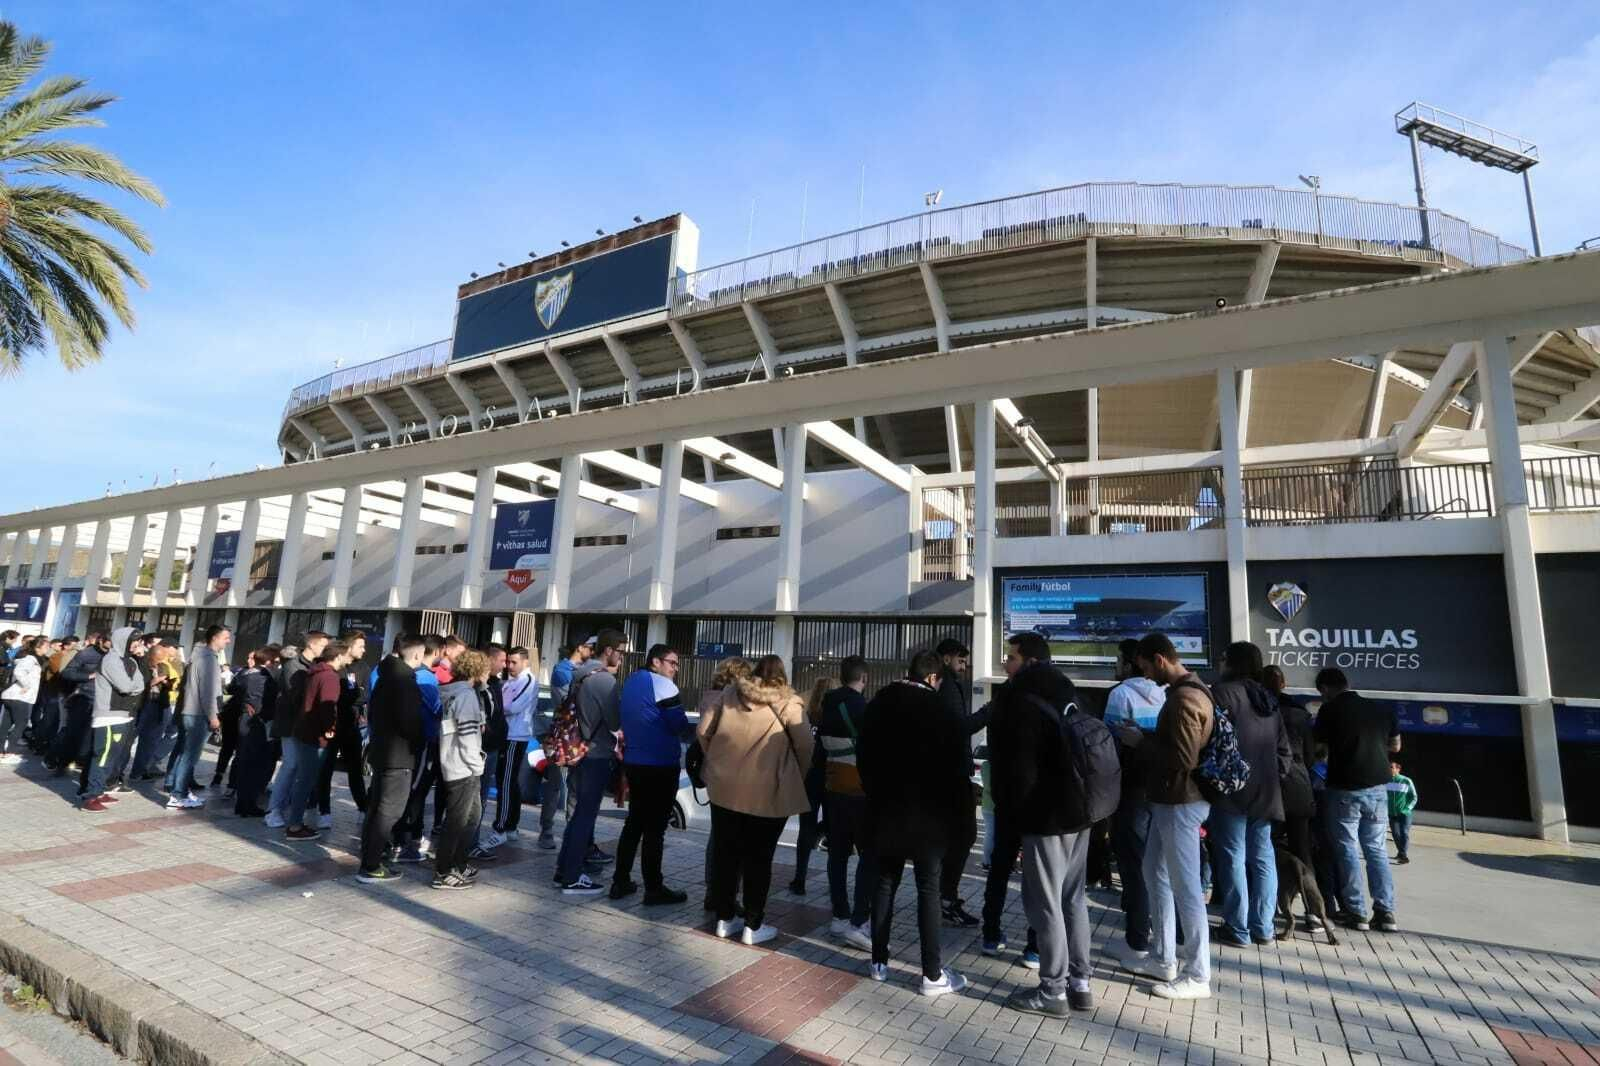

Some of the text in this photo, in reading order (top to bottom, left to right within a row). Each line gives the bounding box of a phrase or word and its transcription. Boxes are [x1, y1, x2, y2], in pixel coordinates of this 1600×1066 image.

[527, 539, 548, 549] salud
[1266, 629, 1418, 649] TAQUILLAS
[1269, 651, 1420, 670] TICKET OFFICES
